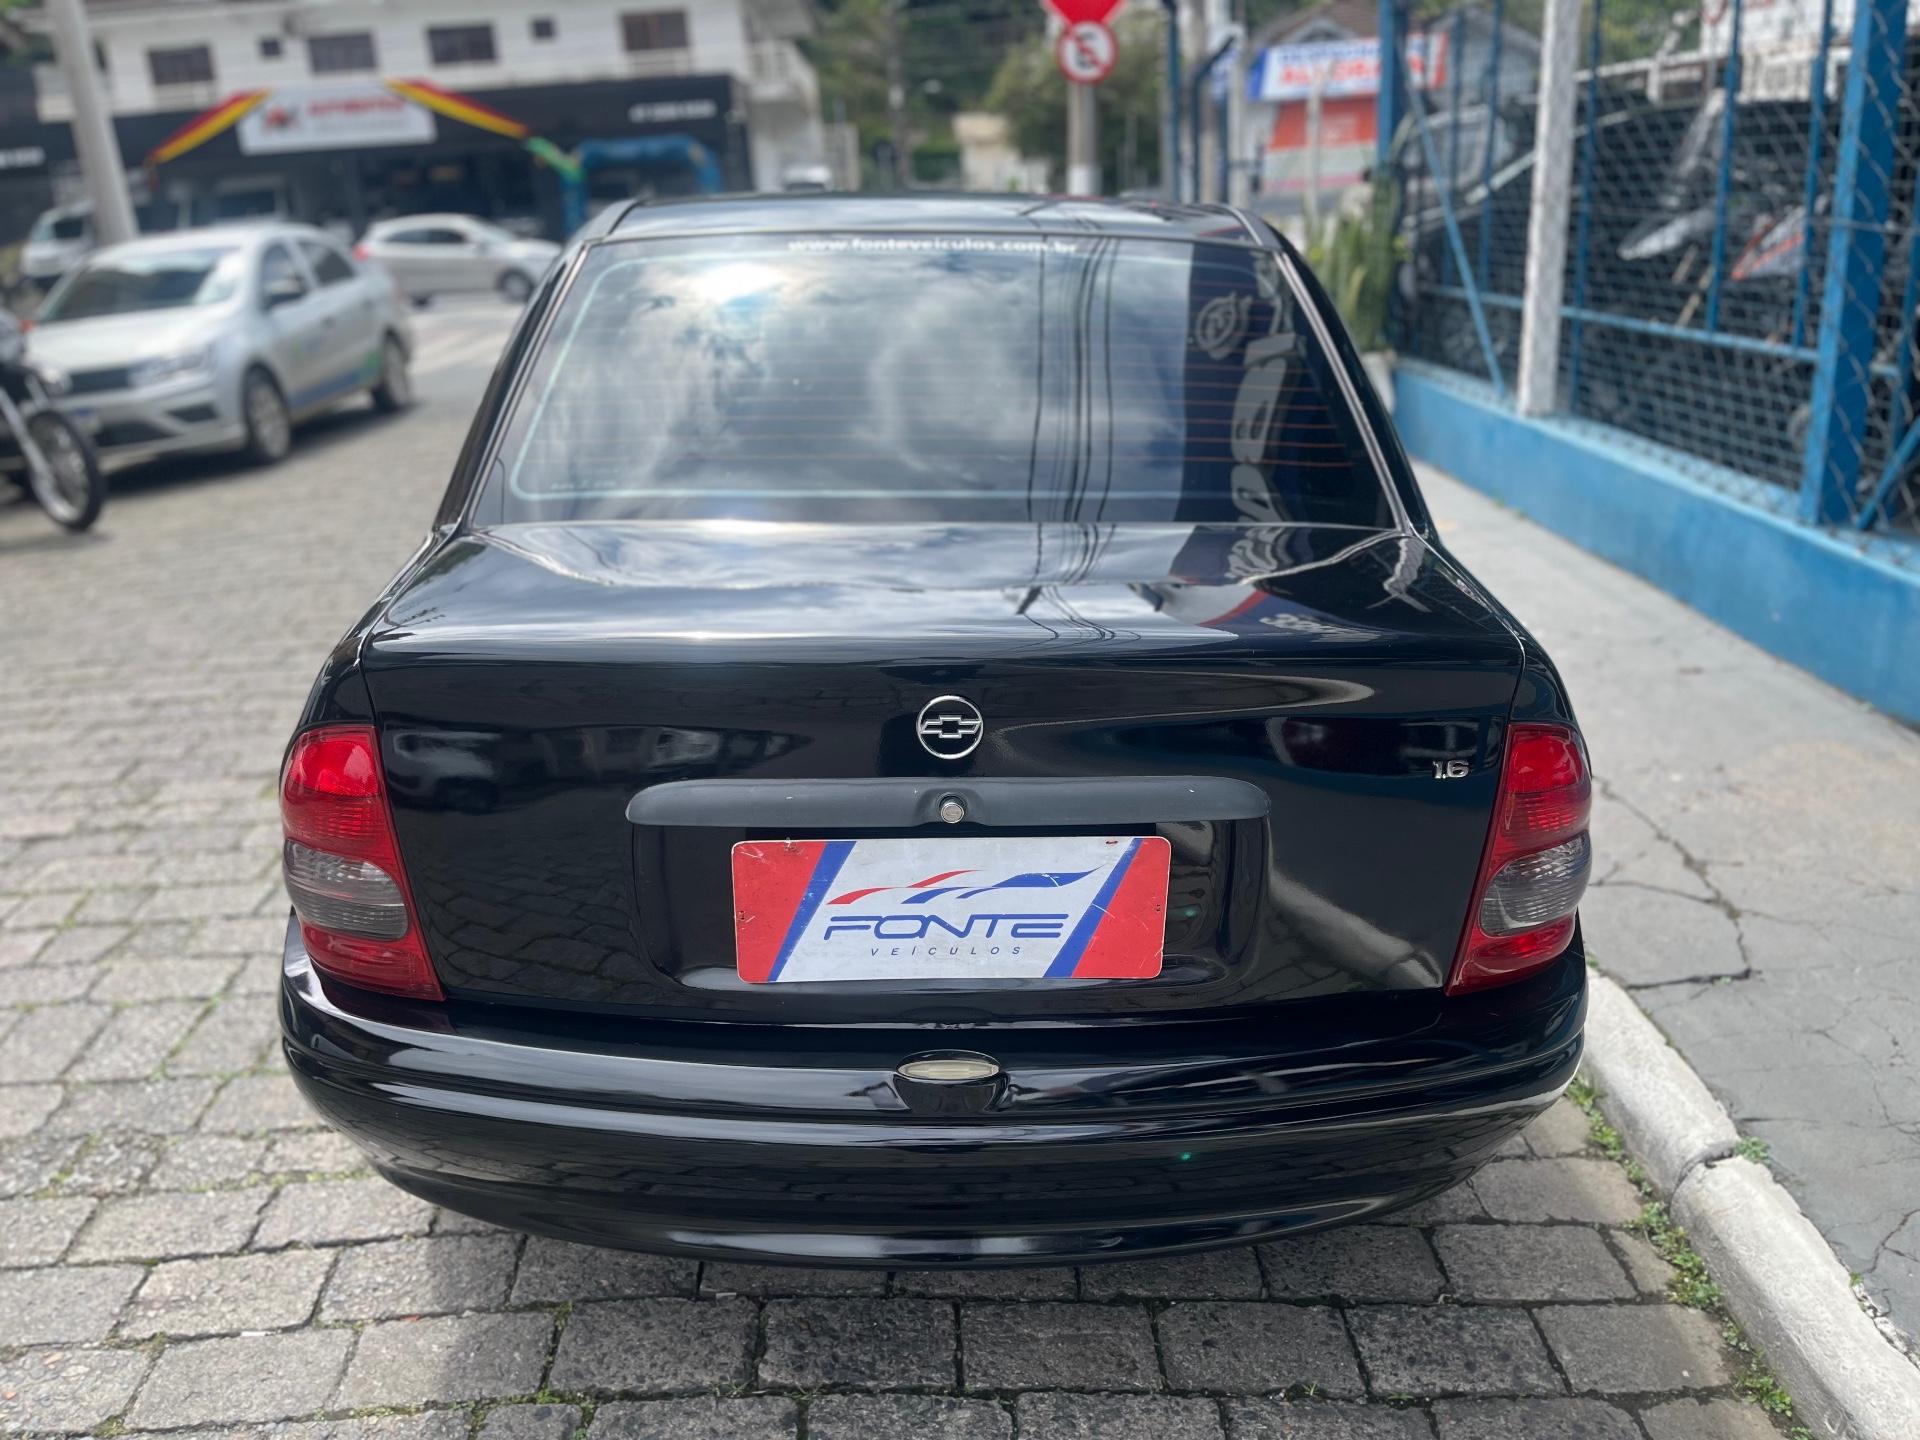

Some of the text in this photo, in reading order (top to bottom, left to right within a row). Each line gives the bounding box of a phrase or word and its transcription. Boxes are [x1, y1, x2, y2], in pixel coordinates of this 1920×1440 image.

[787, 237, 1078, 253] www.fonteveiculos.com.br
[823, 913, 1070, 941] FONTE
[870, 945, 1022, 957] VEÍCULOS
